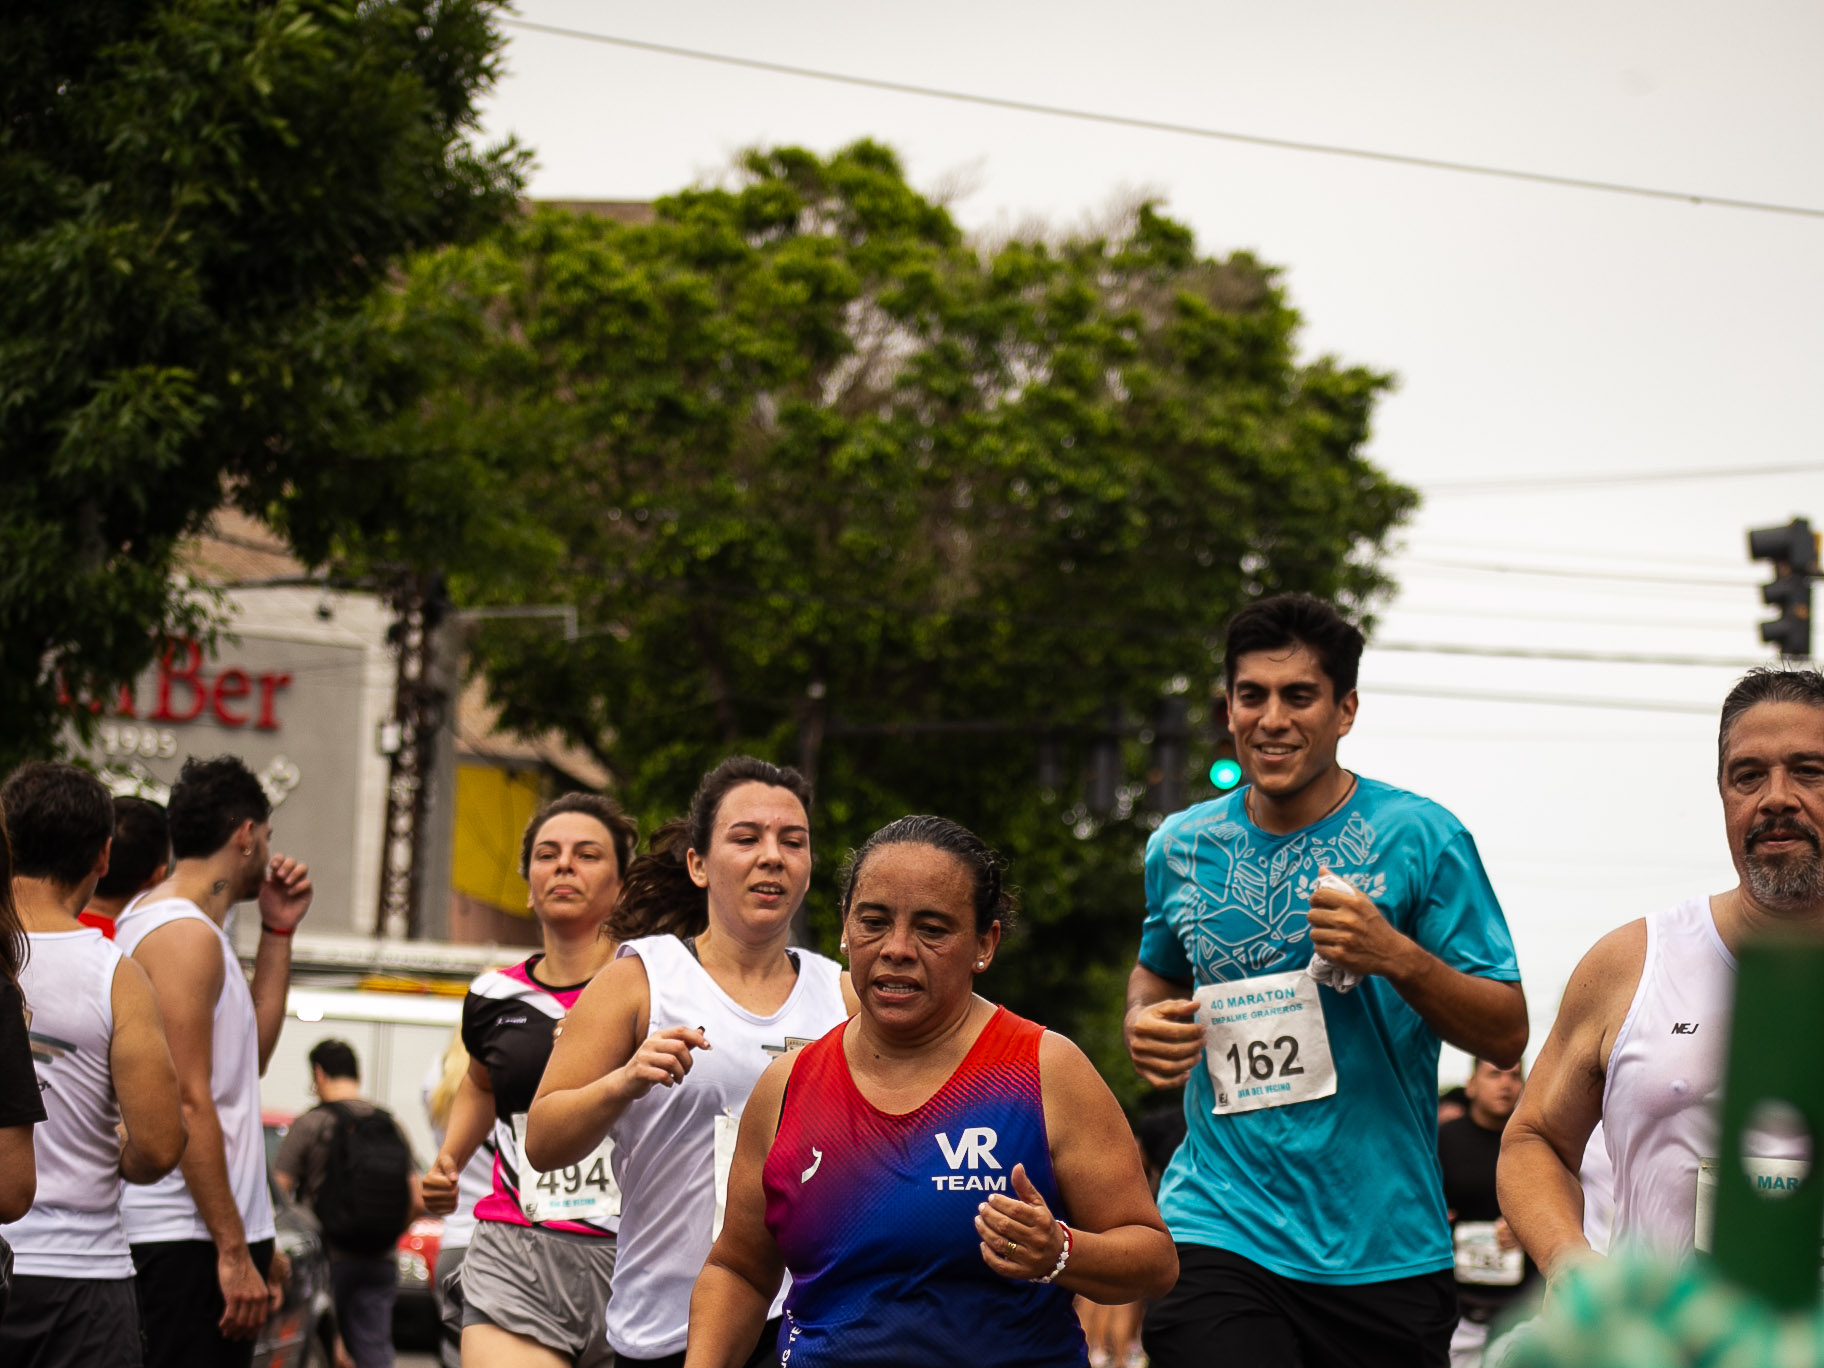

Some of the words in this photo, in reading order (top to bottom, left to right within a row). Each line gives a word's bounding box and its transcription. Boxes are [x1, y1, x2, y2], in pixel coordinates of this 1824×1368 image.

[1210, 999, 1224, 1010] 40
[1227, 988, 1295, 1008] MARATON
[1671, 1023, 1699, 1035] NEJ
[1226, 1035, 1304, 1085] 162
[934, 1127, 1002, 1169] VR
[536, 1157, 610, 1196] 494
[931, 1176, 1006, 1191] TEAM
